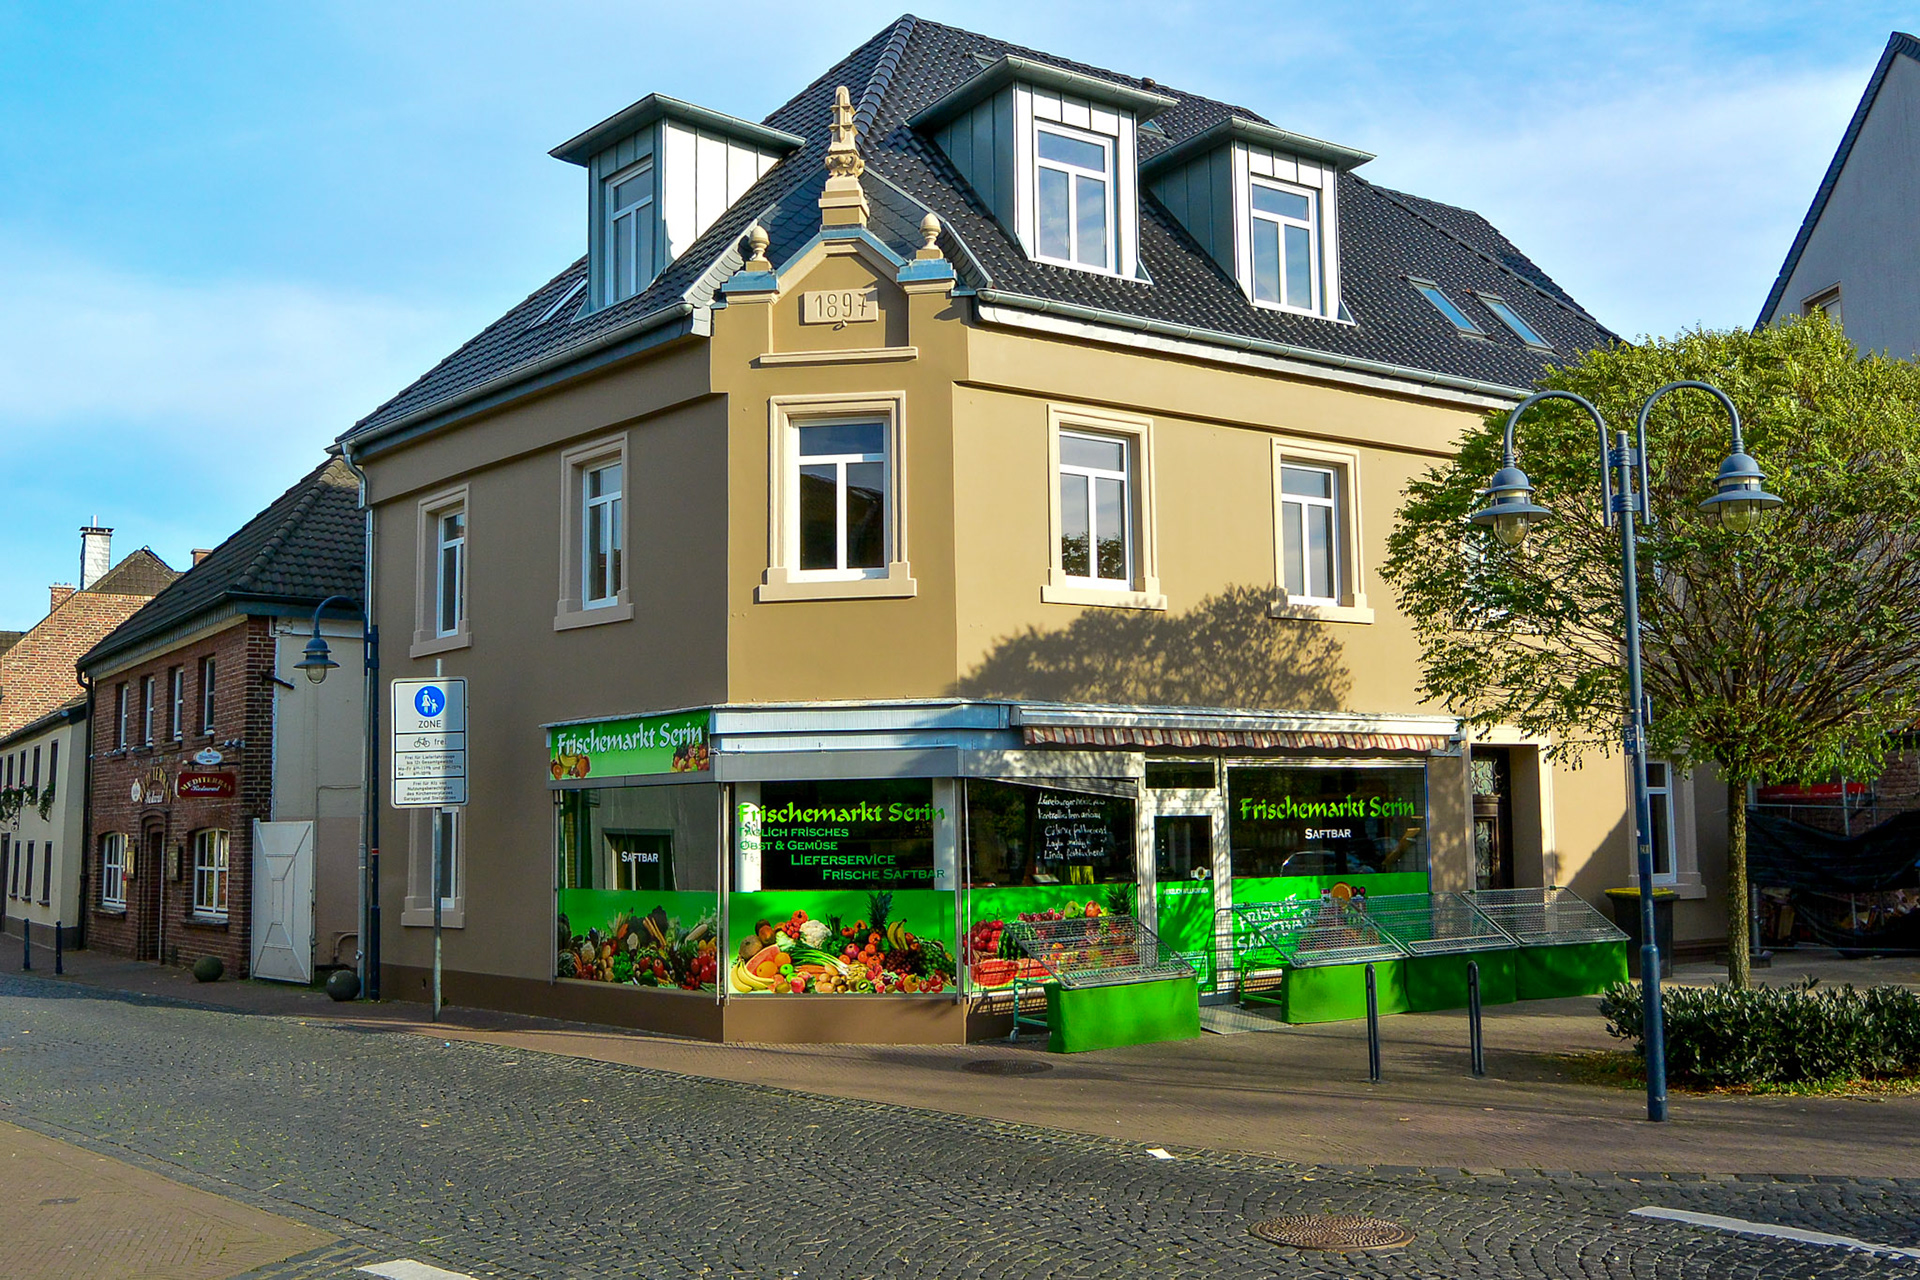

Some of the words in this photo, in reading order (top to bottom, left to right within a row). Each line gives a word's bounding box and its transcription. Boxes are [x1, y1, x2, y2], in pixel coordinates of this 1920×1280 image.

[814, 292, 868, 318] 1897
[418, 720, 442, 729] ZONE
[434, 738, 447, 746] frei
[557, 723, 656, 756] Frischemarkt
[659, 722, 703, 749] Serin
[737, 801, 884, 824] Frischemarkt
[888, 802, 946, 822] Serin
[1239, 794, 1367, 820] Frischemarkt
[1369, 795, 1415, 818] Serin
[791, 826, 850, 838] FRISCHES
[1304, 827, 1352, 840] SAFTBAR
[740, 840, 773, 850] OBST
[775, 840, 785, 850] &
[787, 839, 838, 850] GEMÜSE
[621, 850, 659, 863] SAFTBAR
[791, 854, 896, 866] LIEFERSERVICE
[823, 868, 879, 881] FRISCHE
[883, 867, 945, 880] SAFTBAR
